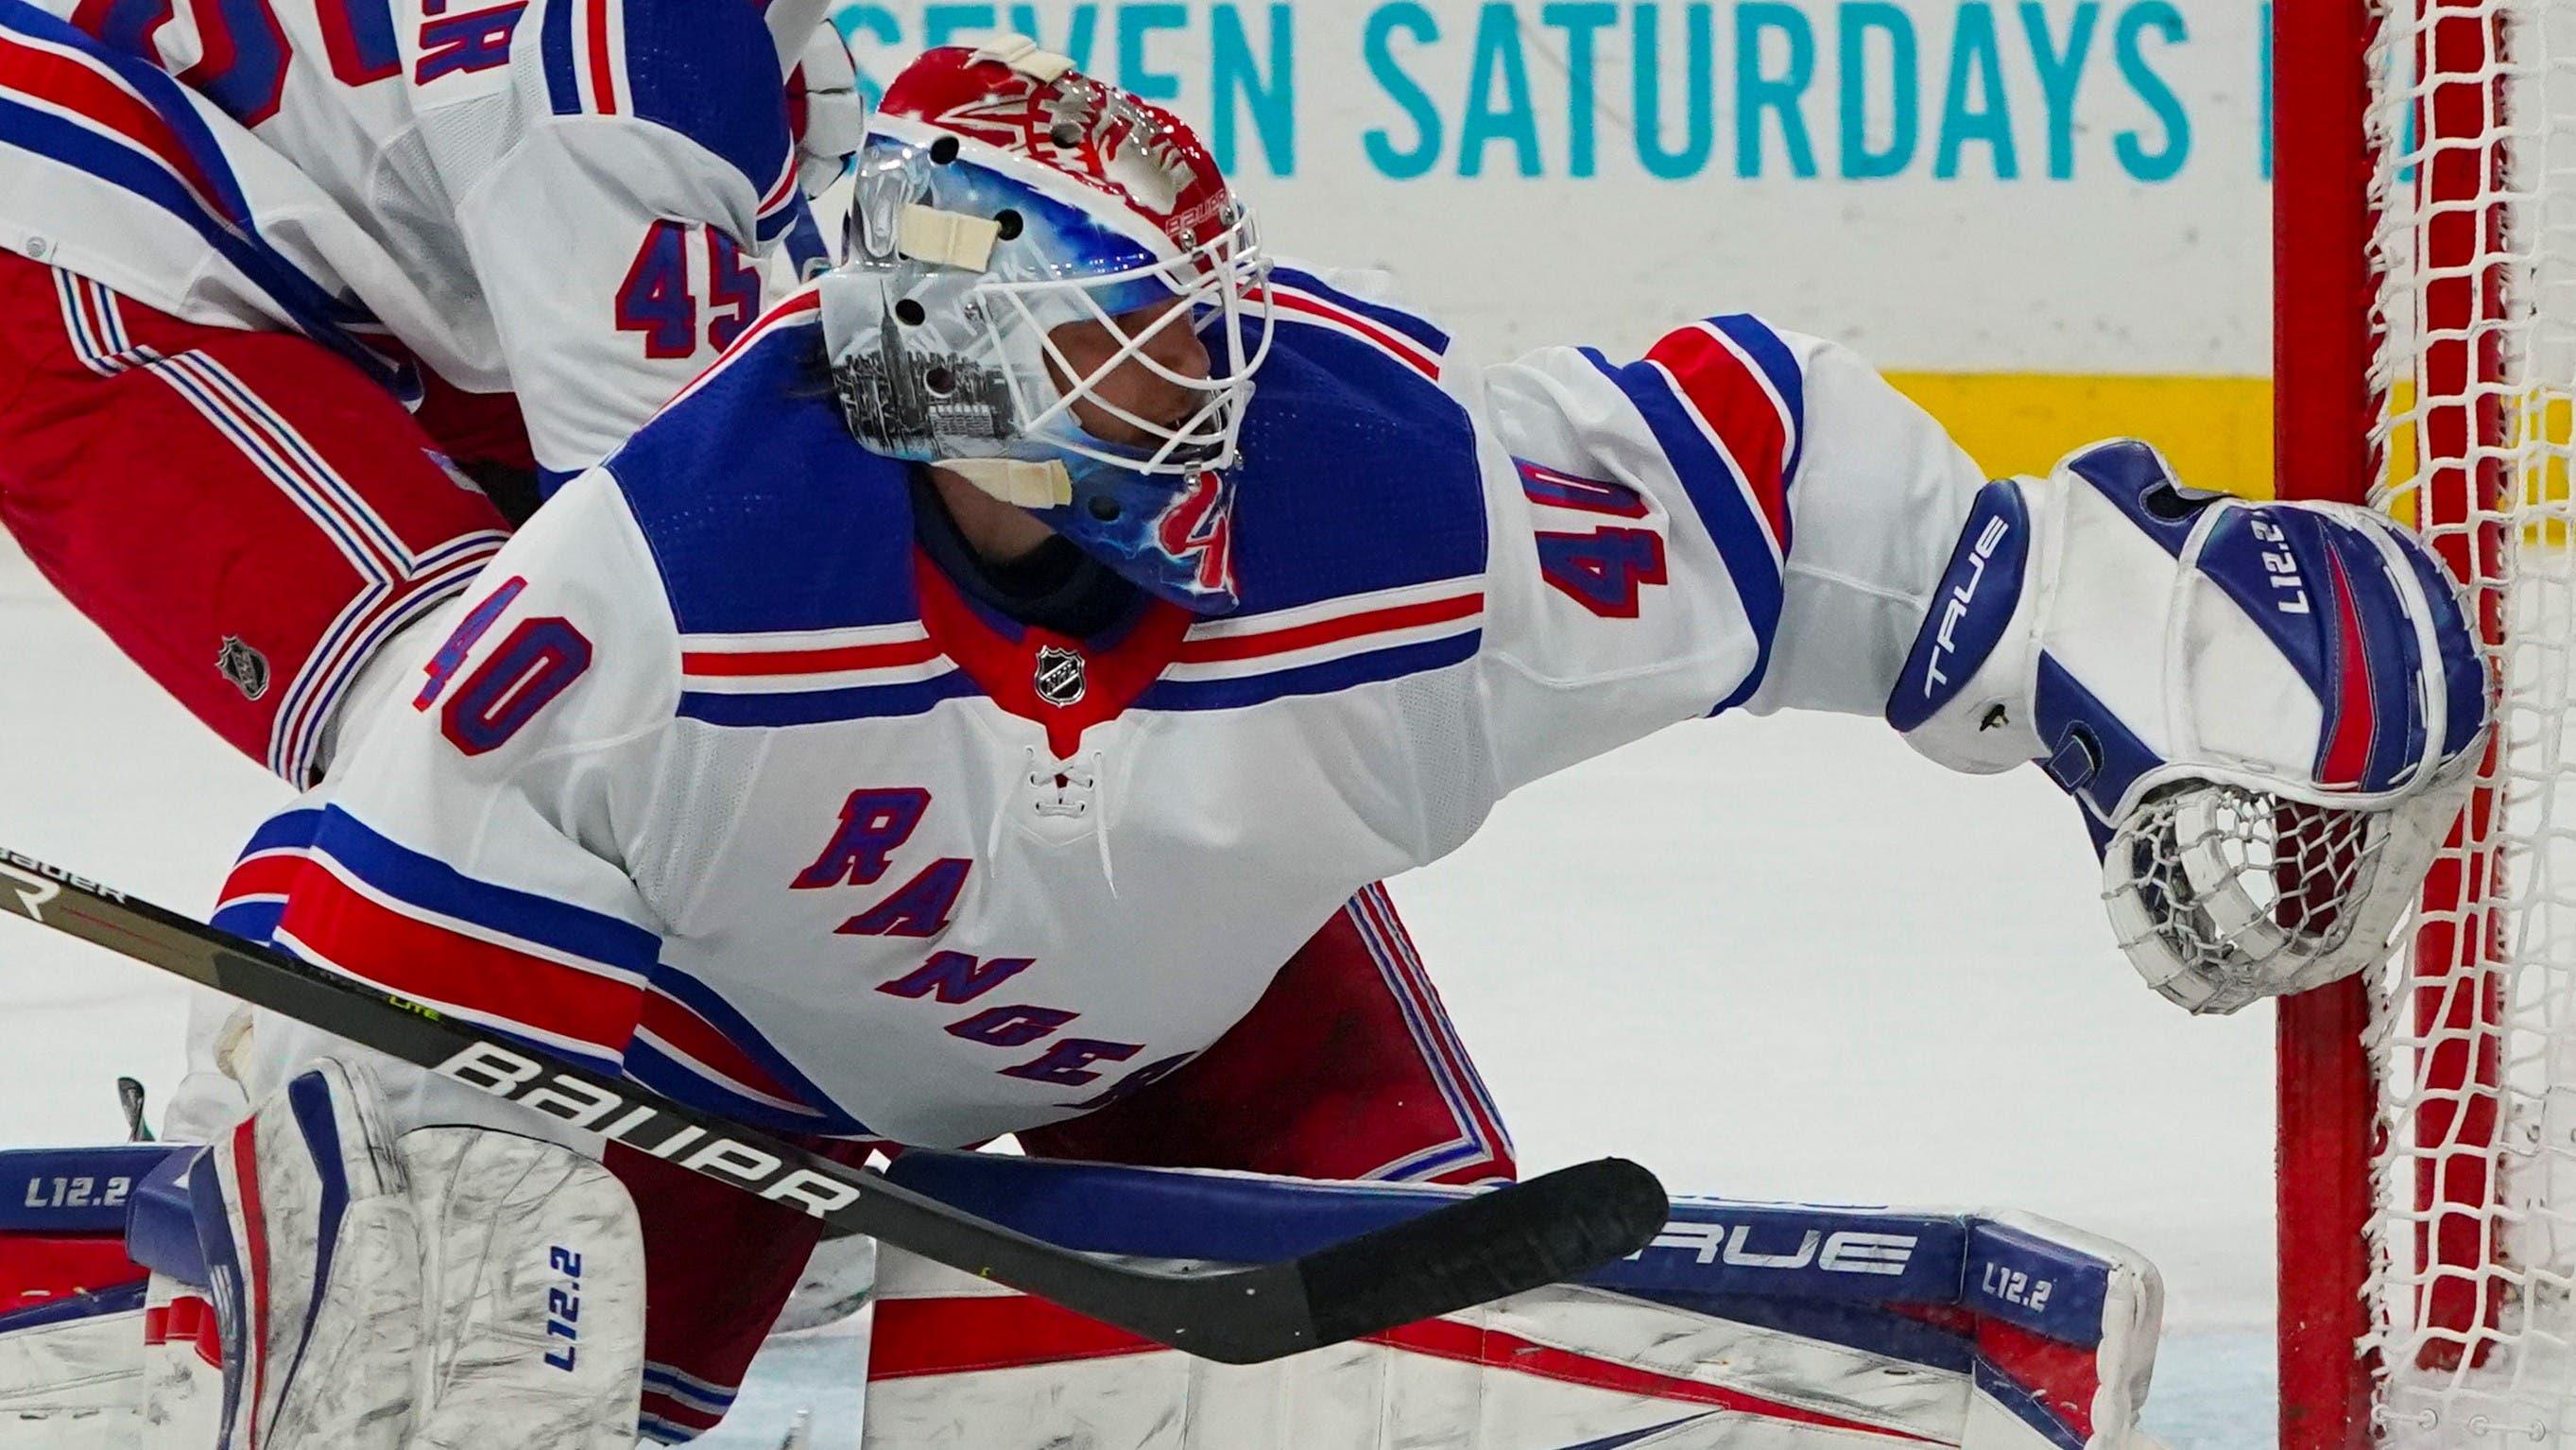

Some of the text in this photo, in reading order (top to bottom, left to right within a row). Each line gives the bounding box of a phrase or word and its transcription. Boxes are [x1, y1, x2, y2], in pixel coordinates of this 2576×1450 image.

[830, 2, 1297, 179] SEN
[1362, 0, 2193, 182] SATURDAYS
[615, 218, 761, 359] 45
[1924, 514, 2009, 699] TRUE
[2250, 519, 2310, 614] L12.2
[25, 1177, 132, 1208] L12.2
[430, 1040, 861, 1219] BAUER
[543, 1245, 583, 1372] L12.2
[1622, 1220, 1918, 1277] RUE
[1982, 1261, 2053, 1314] L12.2
